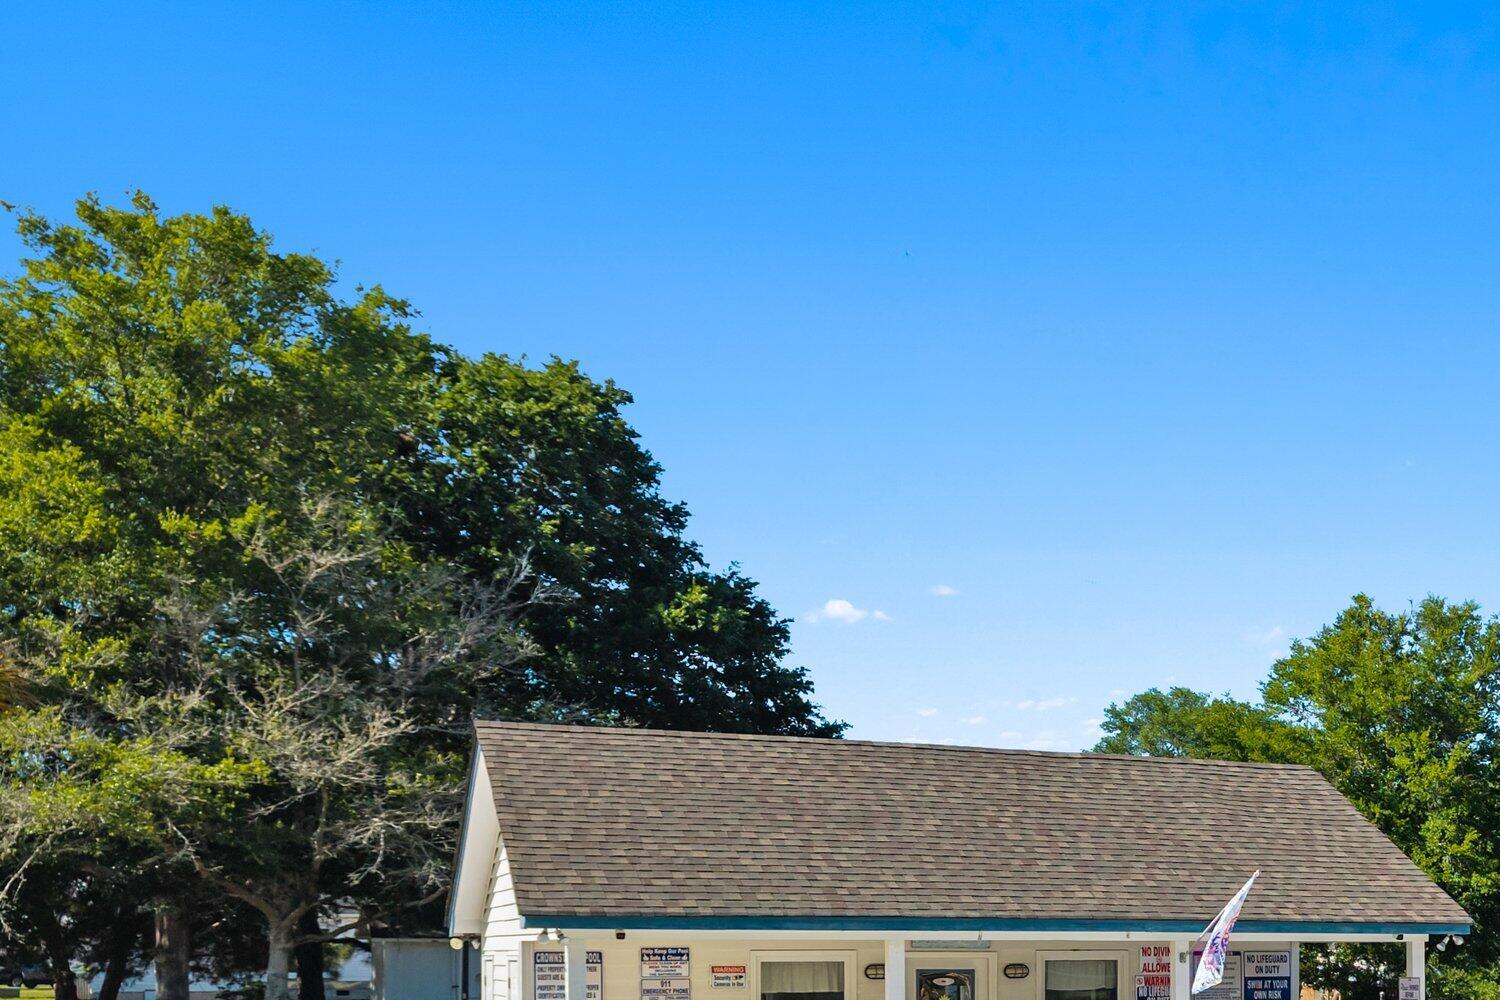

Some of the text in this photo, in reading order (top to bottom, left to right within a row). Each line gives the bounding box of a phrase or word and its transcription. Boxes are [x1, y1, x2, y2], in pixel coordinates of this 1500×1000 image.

[1142, 946, 1170, 956] NO DIVIN
[536, 953, 600, 963] CROWNST OOL
[1247, 955, 1287, 963] NO LIFEGUARD
[1143, 963, 1170, 973] ALLOWE
[1255, 965, 1280, 973] ON DUTY
[1144, 977, 1170, 986] WARNIN
[1247, 980, 1288, 989] SWIM AT YOUR
[1138, 987, 1170, 997] NO LIFEGU
[1253, 991, 1281, 999] OWN RISK
